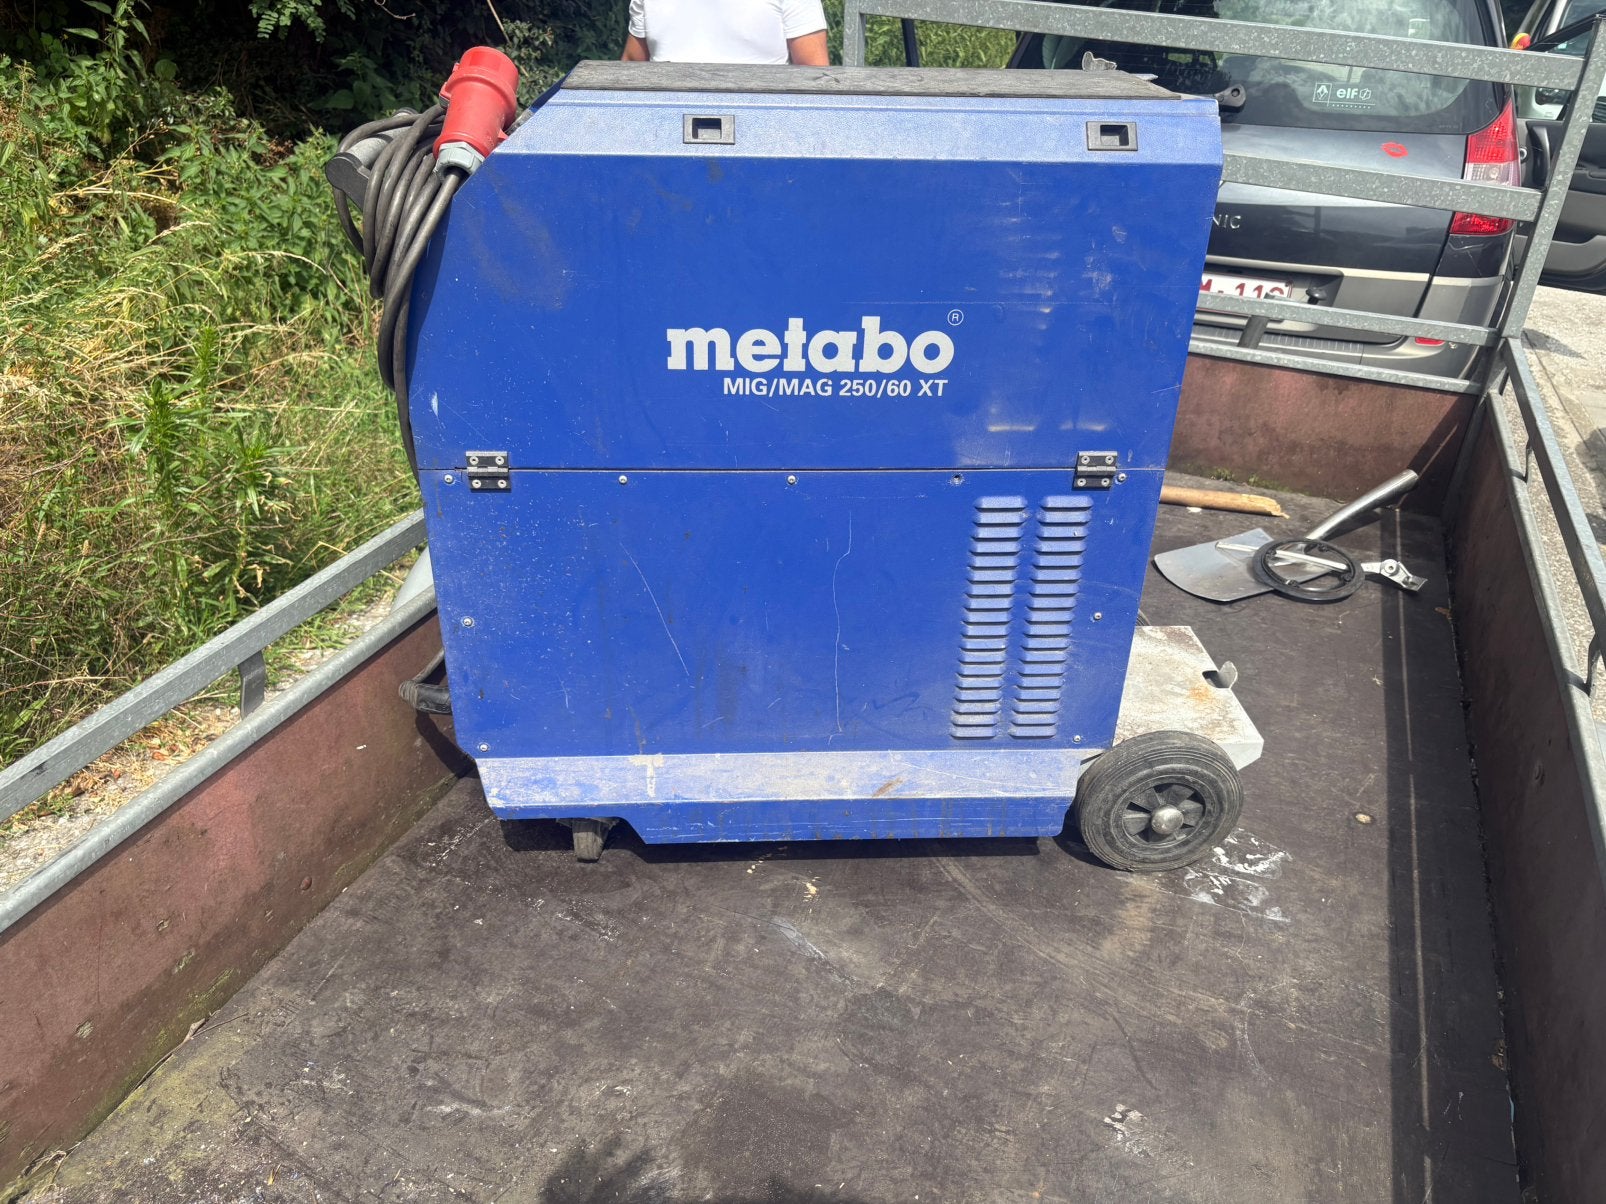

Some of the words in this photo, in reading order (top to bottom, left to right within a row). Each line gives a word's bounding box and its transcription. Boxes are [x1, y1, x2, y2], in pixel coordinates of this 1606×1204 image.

[1336, 88, 1359, 99] elf
[666, 315, 955, 374] metabo
[723, 377, 833, 397] MIG/MAG
[839, 379, 912, 398] 250/60
[917, 379, 949, 397] XT
